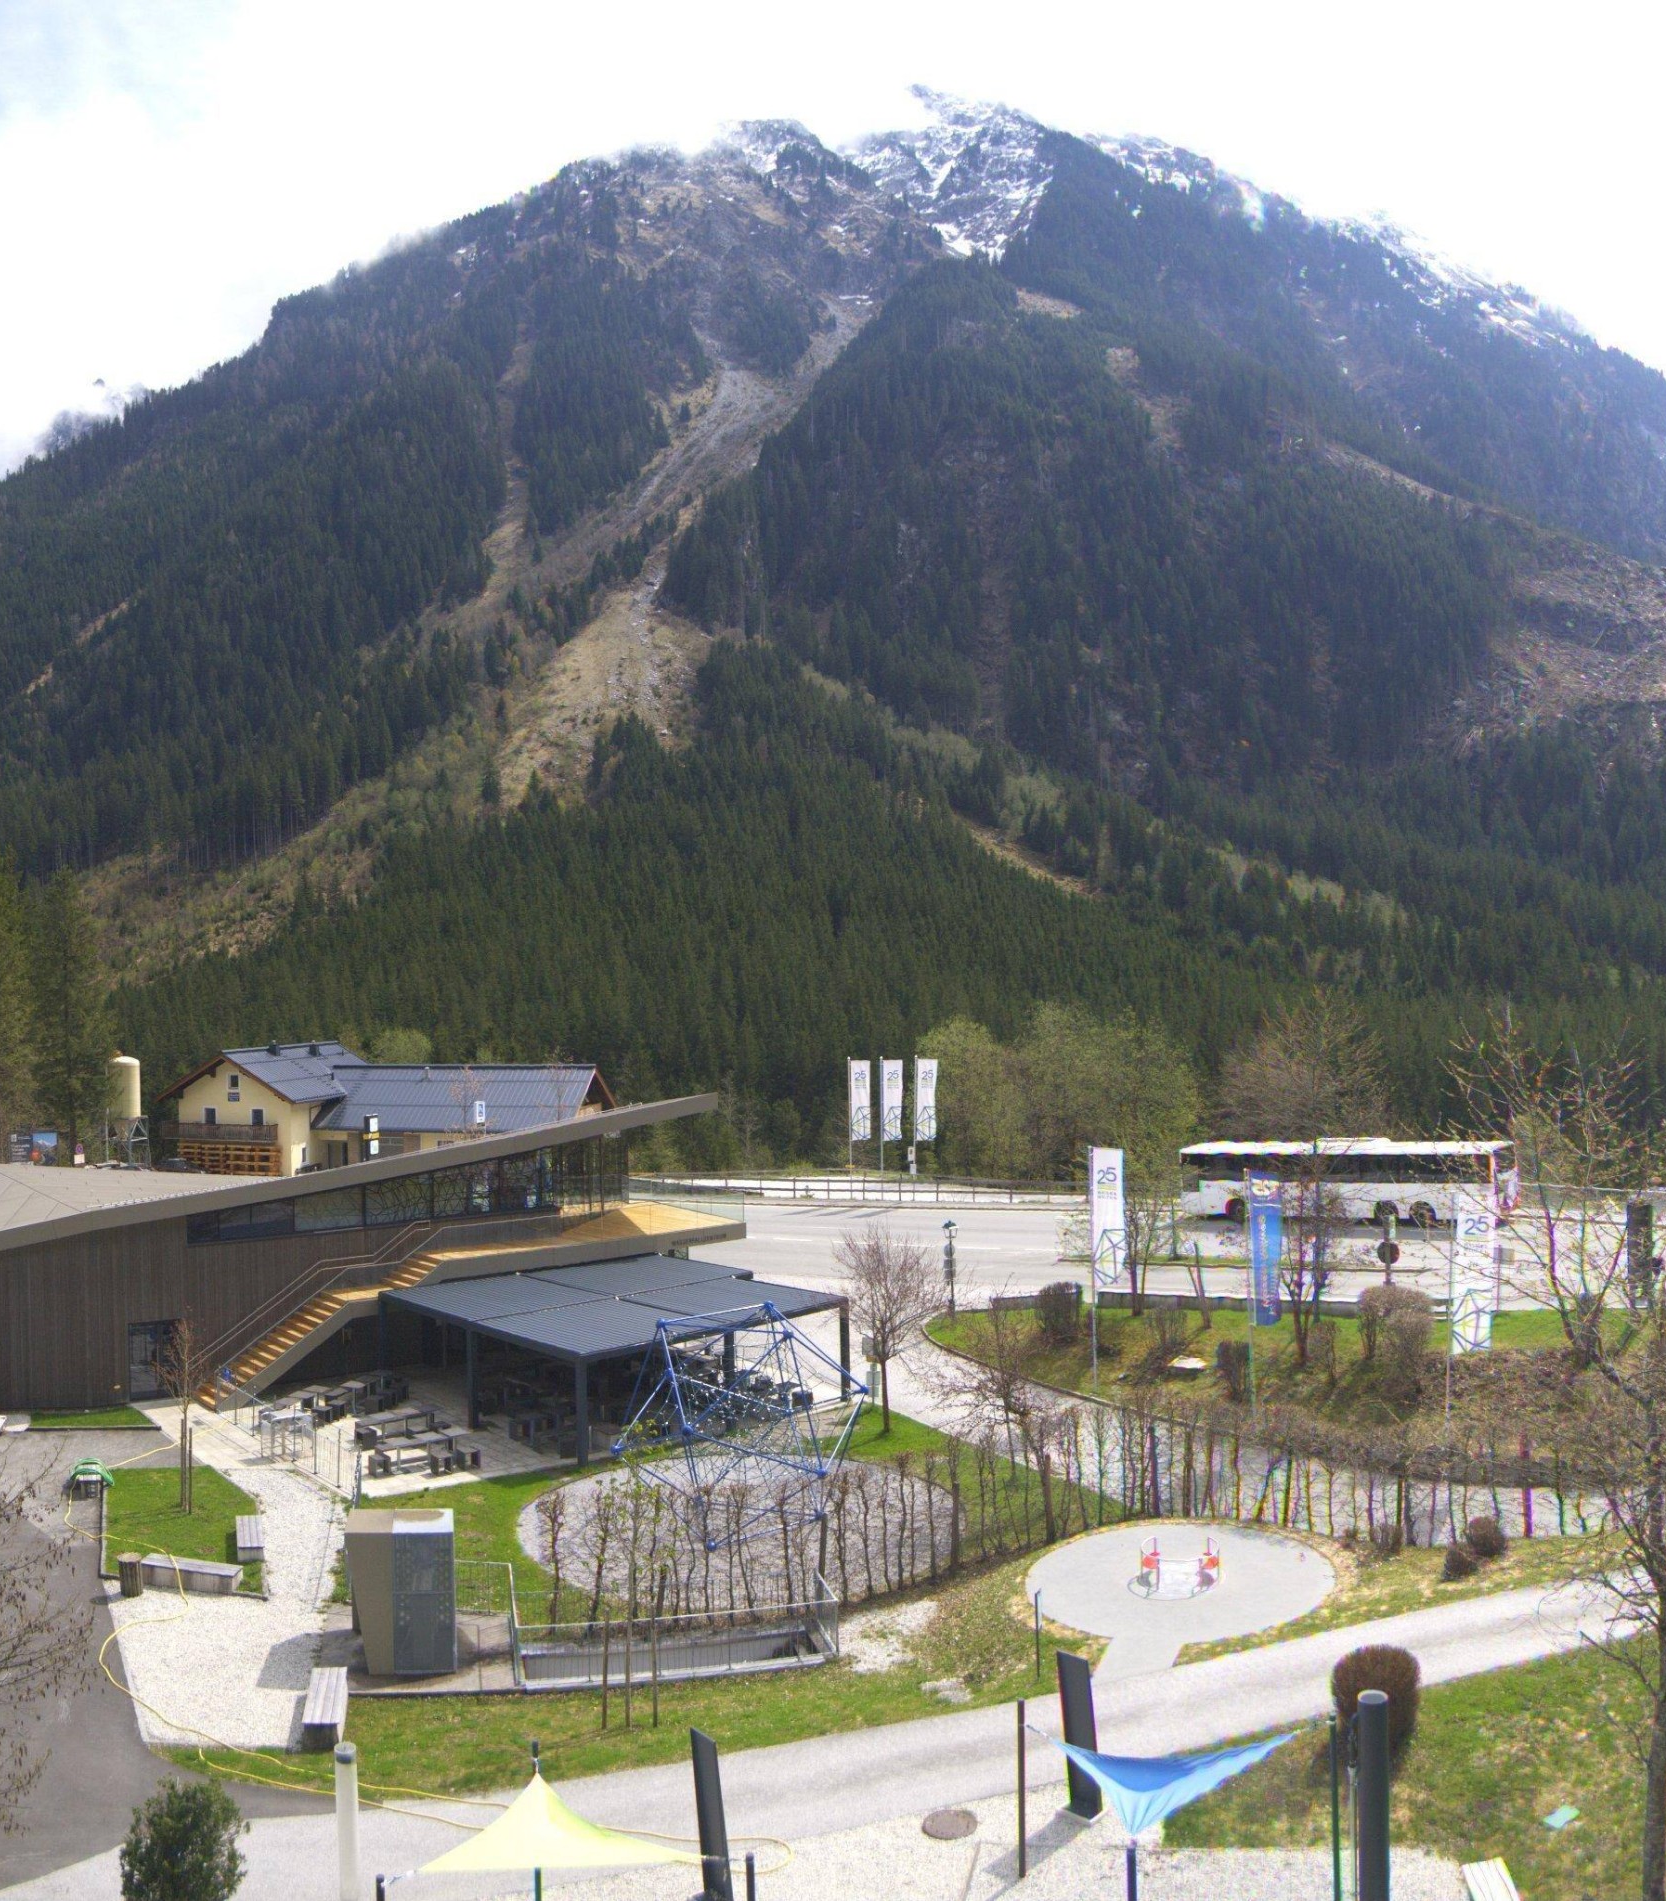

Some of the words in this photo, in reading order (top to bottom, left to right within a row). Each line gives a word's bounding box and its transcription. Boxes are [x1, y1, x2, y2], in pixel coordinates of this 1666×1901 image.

[855, 1070, 866, 1080] 25
[887, 1070, 899, 1080] 25
[922, 1070, 933, 1080] 25
[1097, 1167, 1117, 1184] 25
[1464, 1216, 1489, 1235] 25
